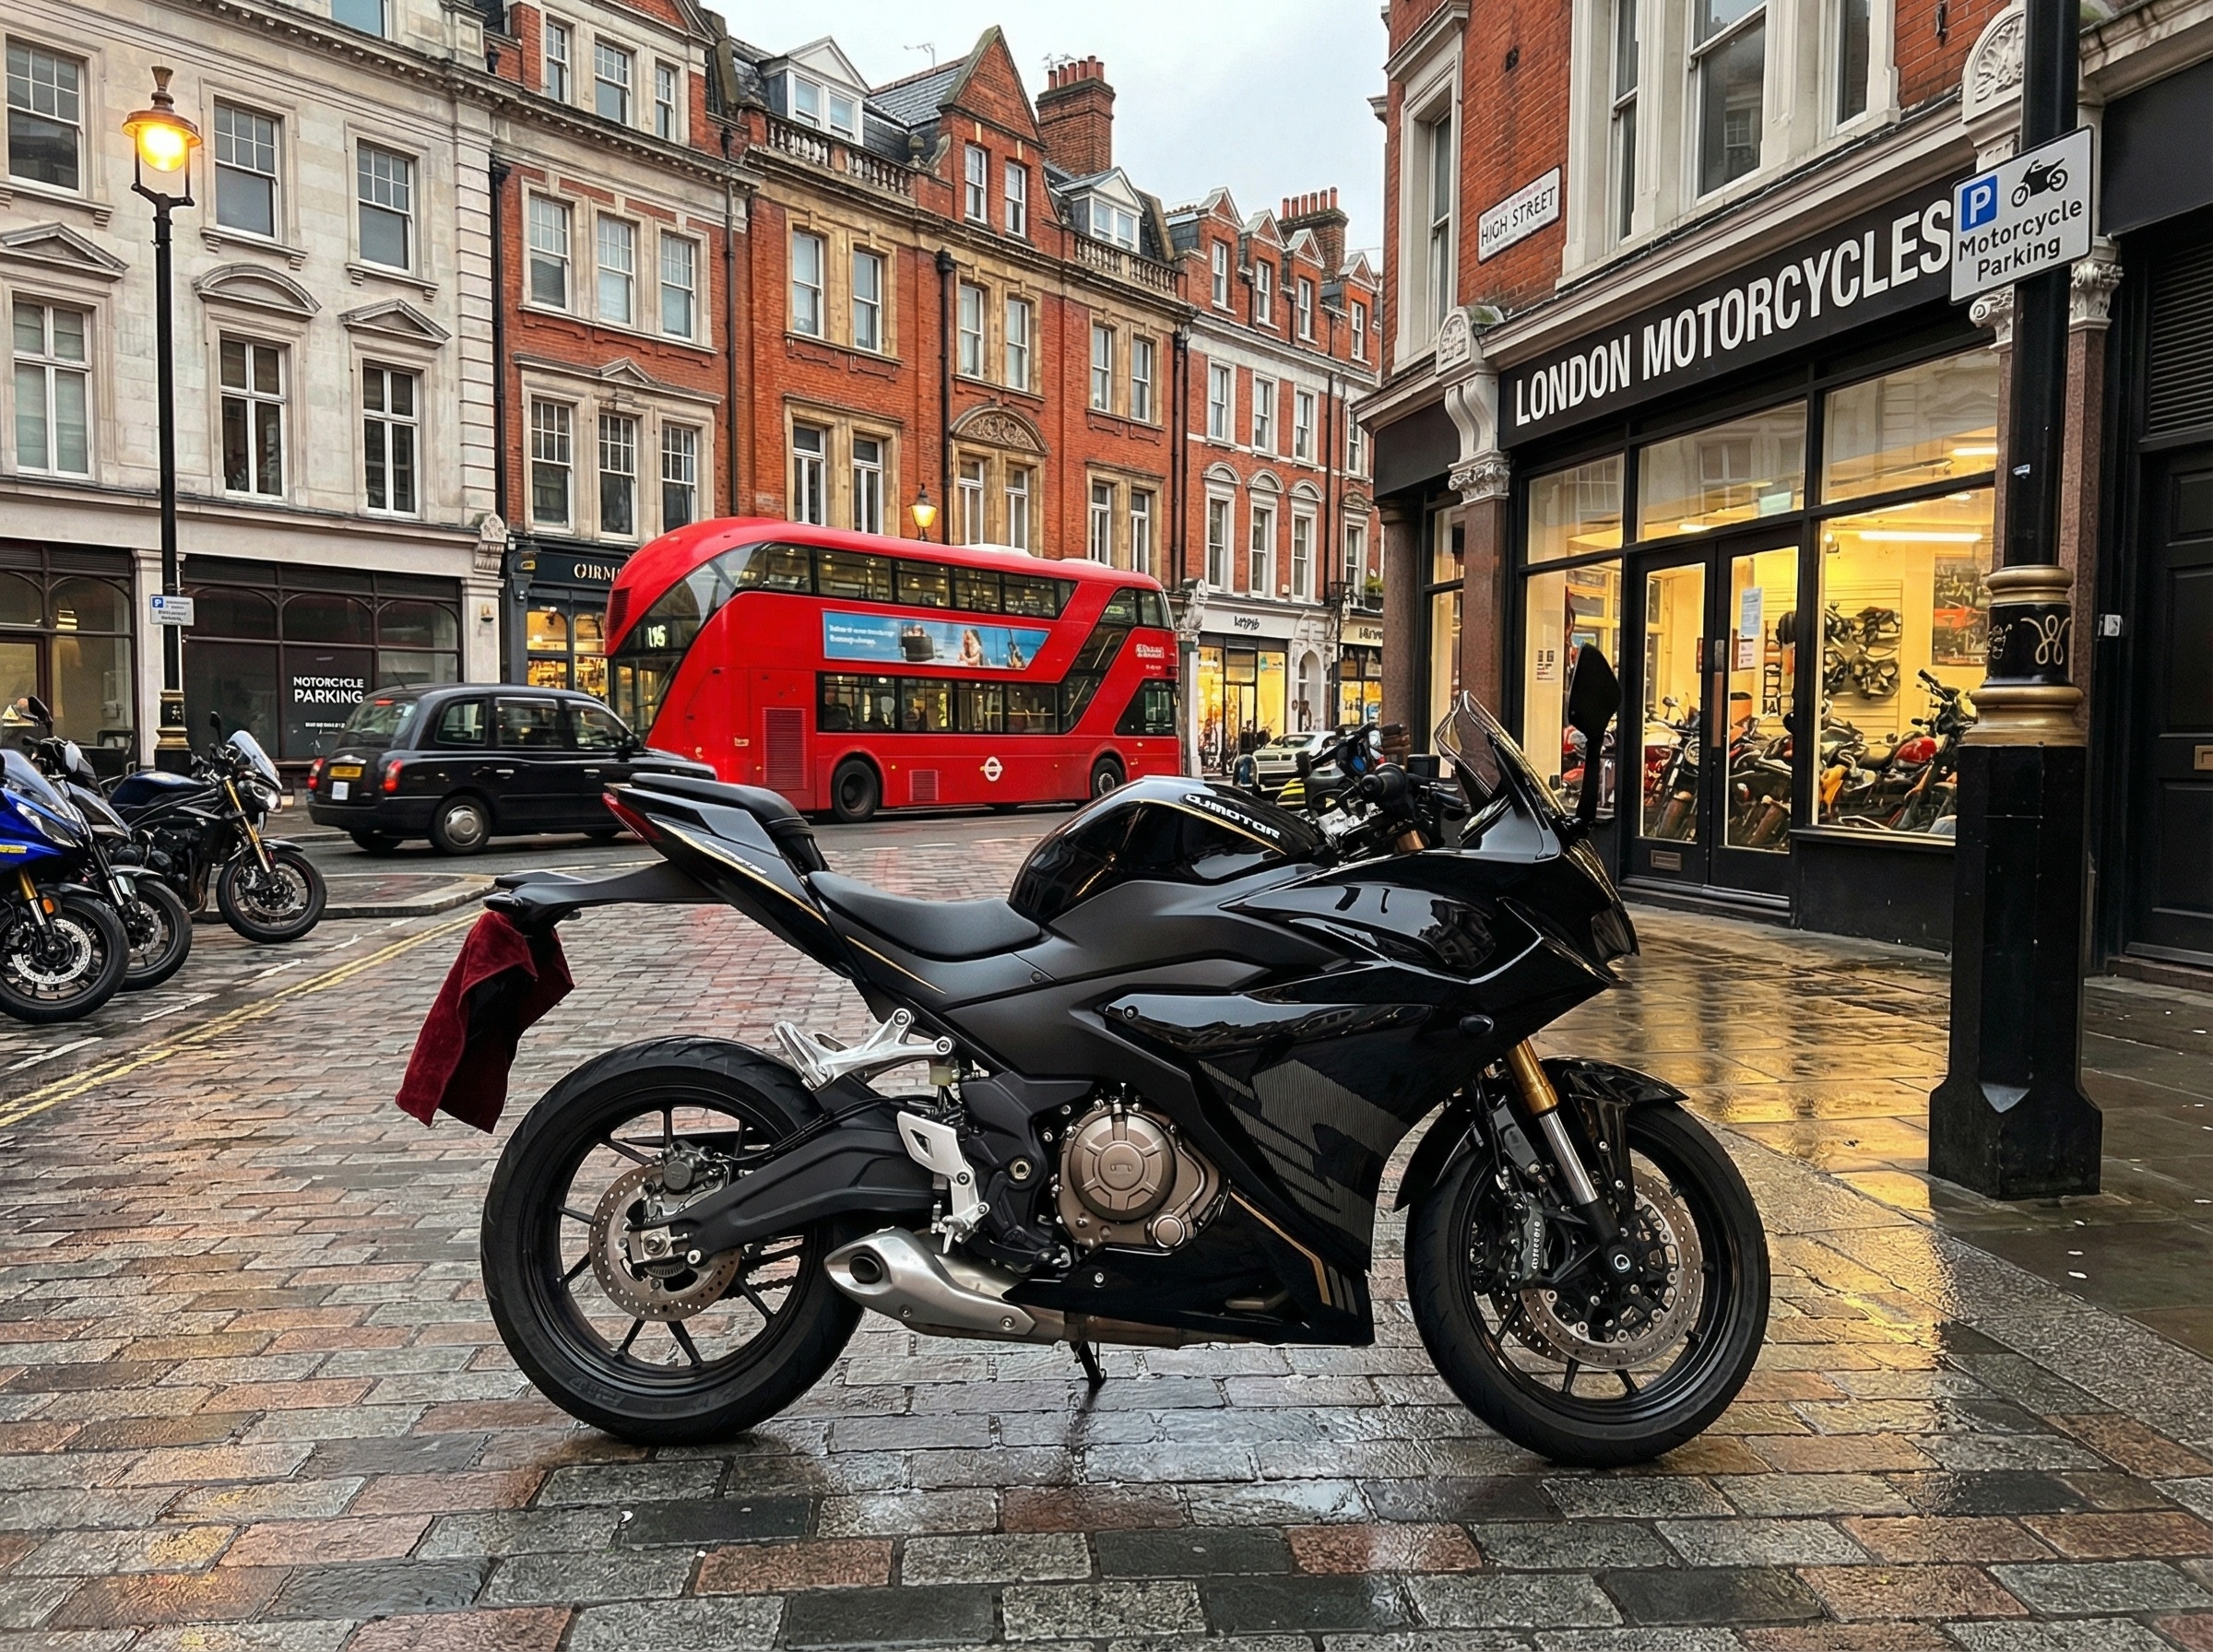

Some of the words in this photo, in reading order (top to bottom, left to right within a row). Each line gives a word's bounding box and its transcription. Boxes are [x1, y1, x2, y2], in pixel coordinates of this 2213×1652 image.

[1481, 216, 1508, 247] HIGH
[1512, 186, 1556, 228] STREET
[1970, 185, 1992, 225] P
[1959, 200, 2083, 262] Motorcycle
[1977, 236, 2061, 282] Parking
[1516, 334, 1630, 427] LONDON
[1642, 199, 1952, 381] MOTORCYCLES
[294, 689, 363, 703] PARKING
[1185, 794, 1281, 839] QJMOTOR
